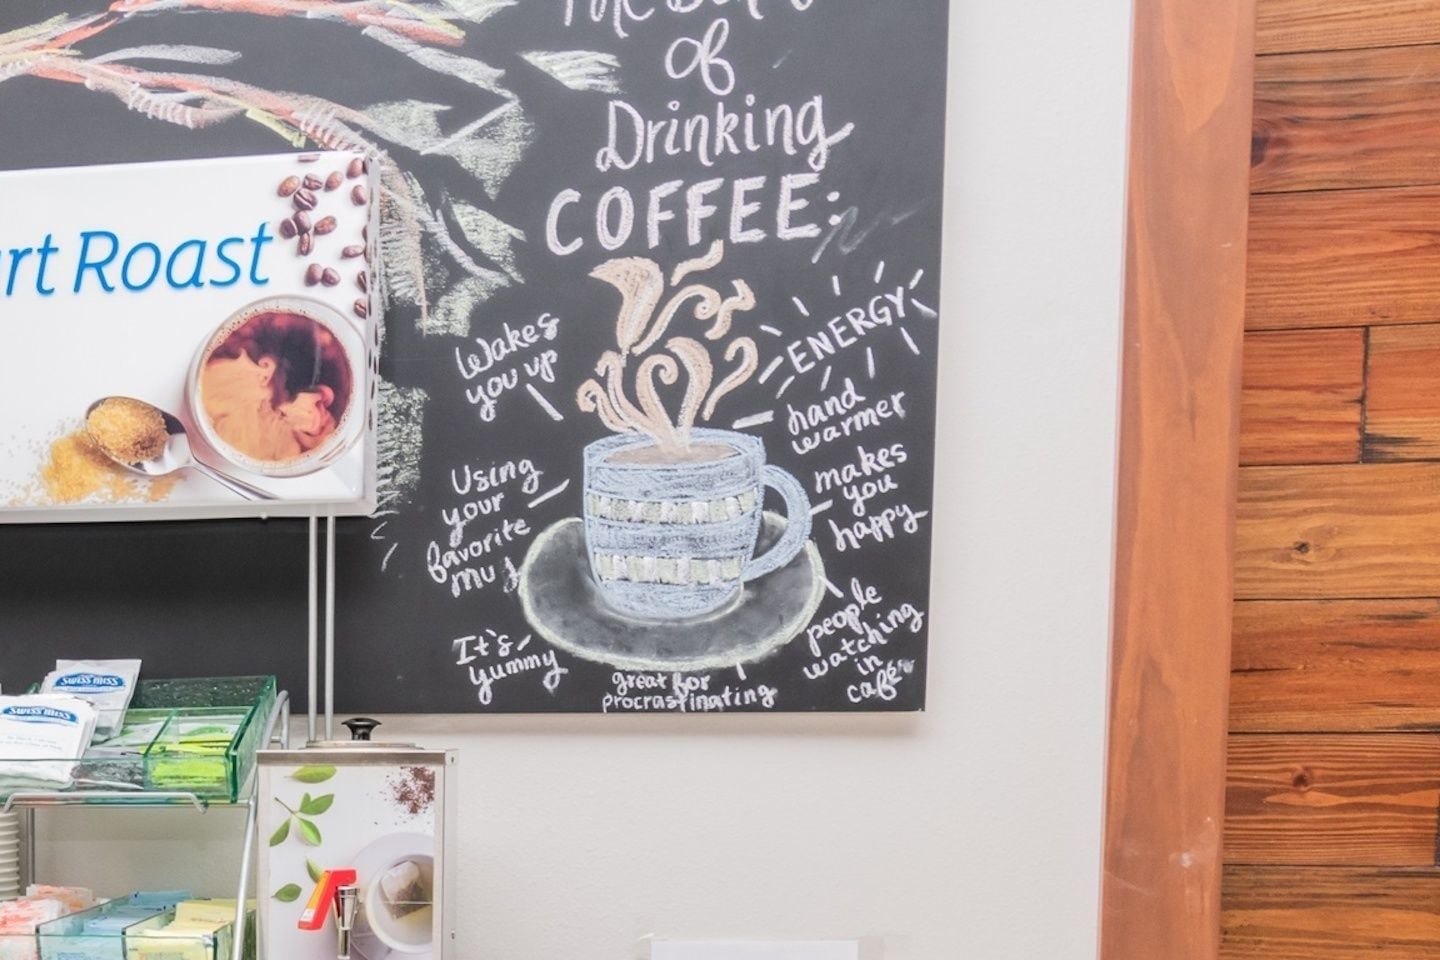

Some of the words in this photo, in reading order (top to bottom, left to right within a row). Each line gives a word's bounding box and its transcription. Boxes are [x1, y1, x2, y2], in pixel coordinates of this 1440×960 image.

[665, 17, 736, 96] of
[595, 94, 855, 172] Drinking
[546, 173, 840, 256] COFFEE:
[73, 221, 274, 294] Roast
[455, 312, 560, 380] Wakes
[787, 286, 905, 374] ENERGY
[465, 369, 518, 422] you
[524, 349, 559, 383] up
[787, 377, 866, 436] hand
[792, 391, 906, 455] warmer
[451, 457, 543, 495] Using
[815, 443, 908, 494] makes
[843, 474, 898, 517] you
[426, 517, 531, 584] favorite
[442, 491, 505, 547] your
[828, 503, 929, 552] happy
[803, 603, 924, 680] watching
[806, 577, 882, 657] people
[469, 648, 568, 705] yummy
[612, 671, 668, 696] great
[672, 671, 711, 697] for
[854, 654, 883, 676] in
[602, 684, 779, 713] procrastinating
